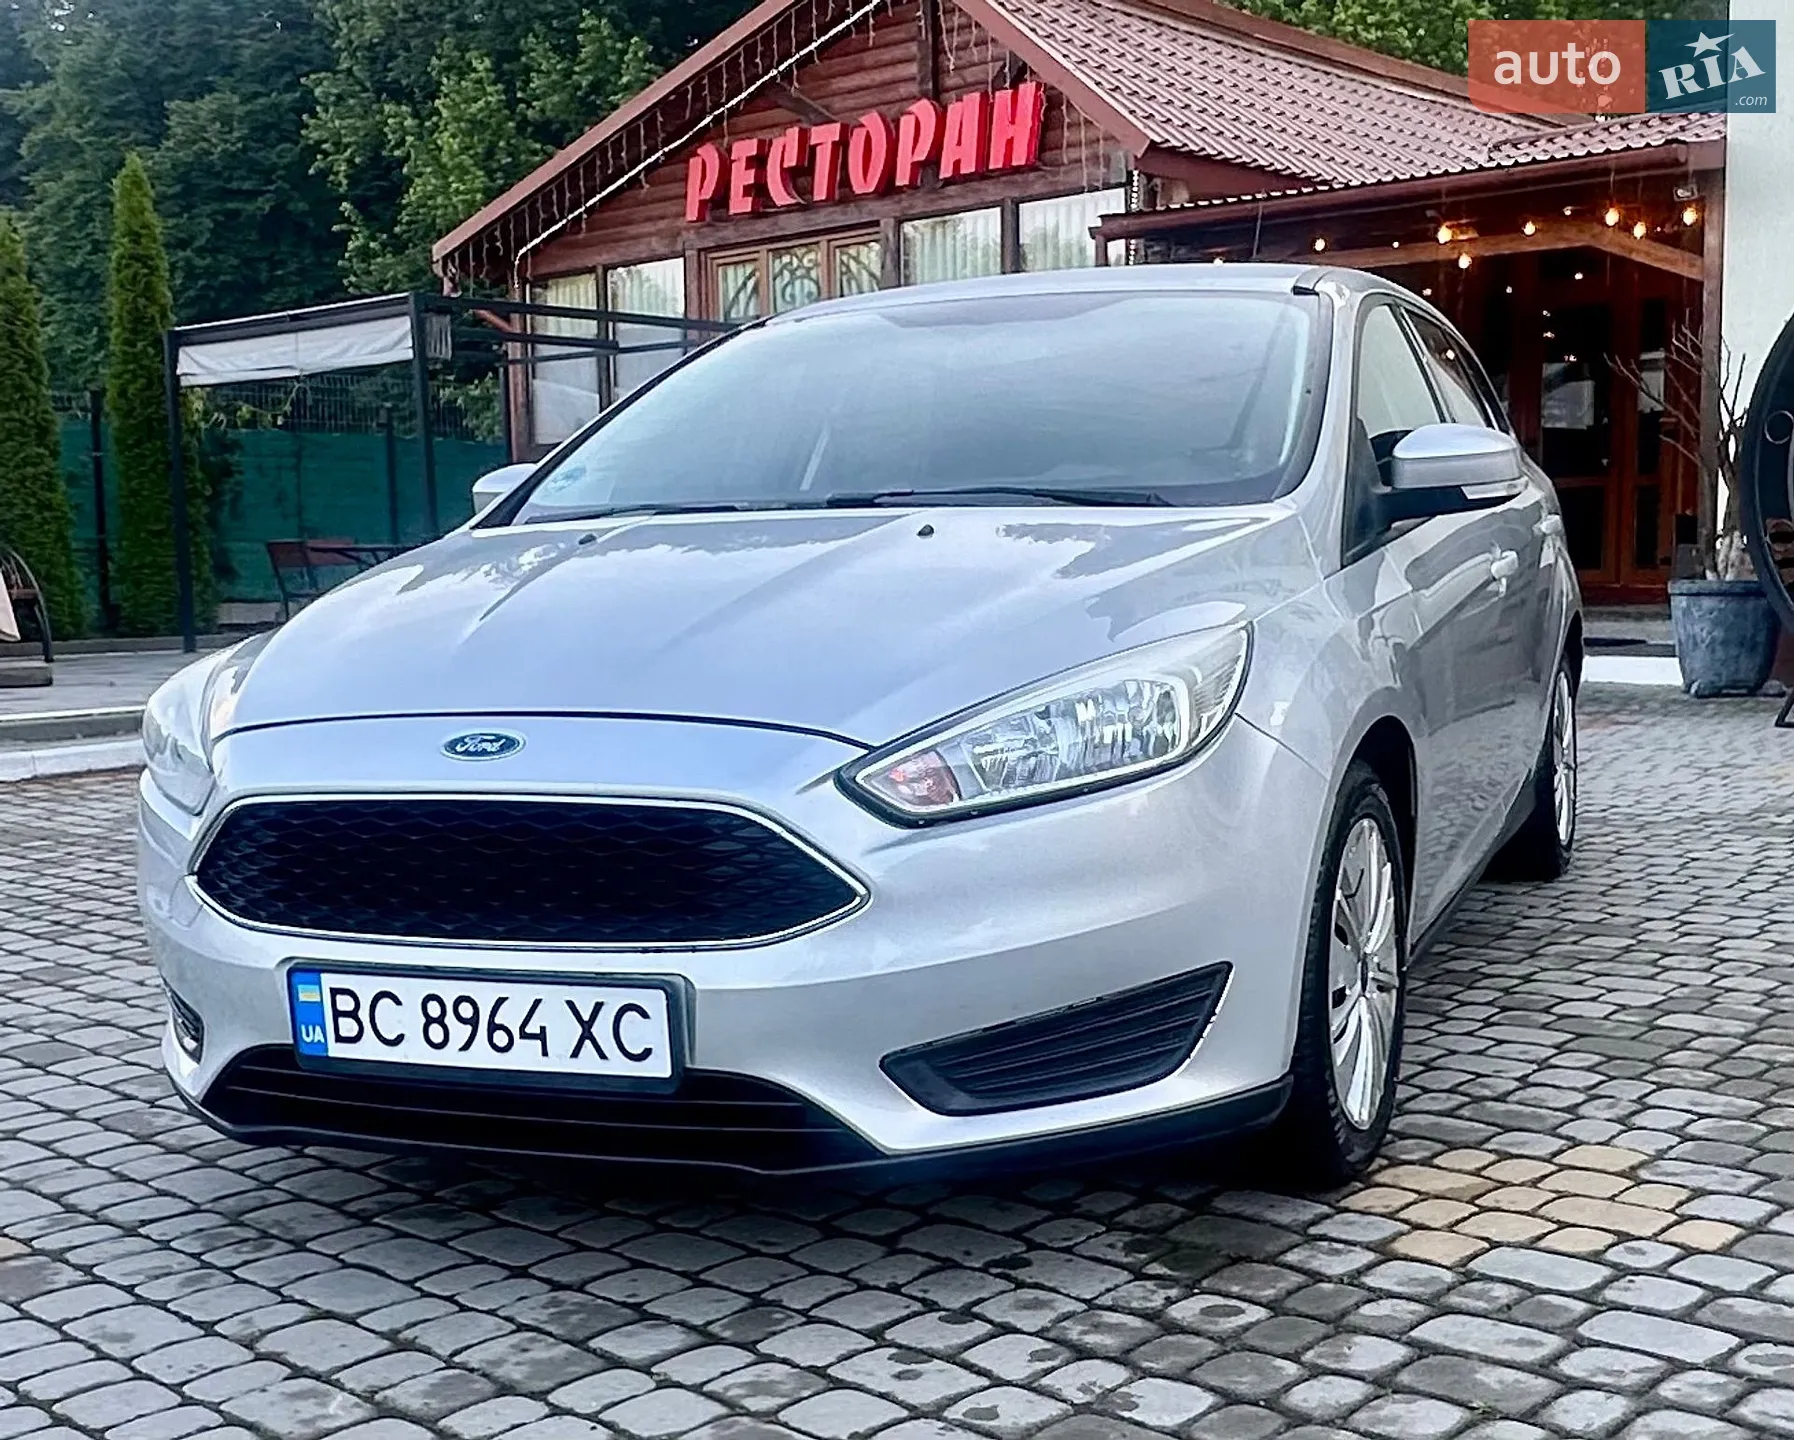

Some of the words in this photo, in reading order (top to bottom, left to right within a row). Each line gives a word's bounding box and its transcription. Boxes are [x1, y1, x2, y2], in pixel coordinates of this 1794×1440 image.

[685, 81, 1044, 222] РЕСТОРАН
[455, 735, 506, 752] Ford
[301, 1024, 325, 1043] UA
[329, 987, 405, 1048] BC
[421, 993, 549, 1058] 8964
[566, 999, 653, 1062] XC
